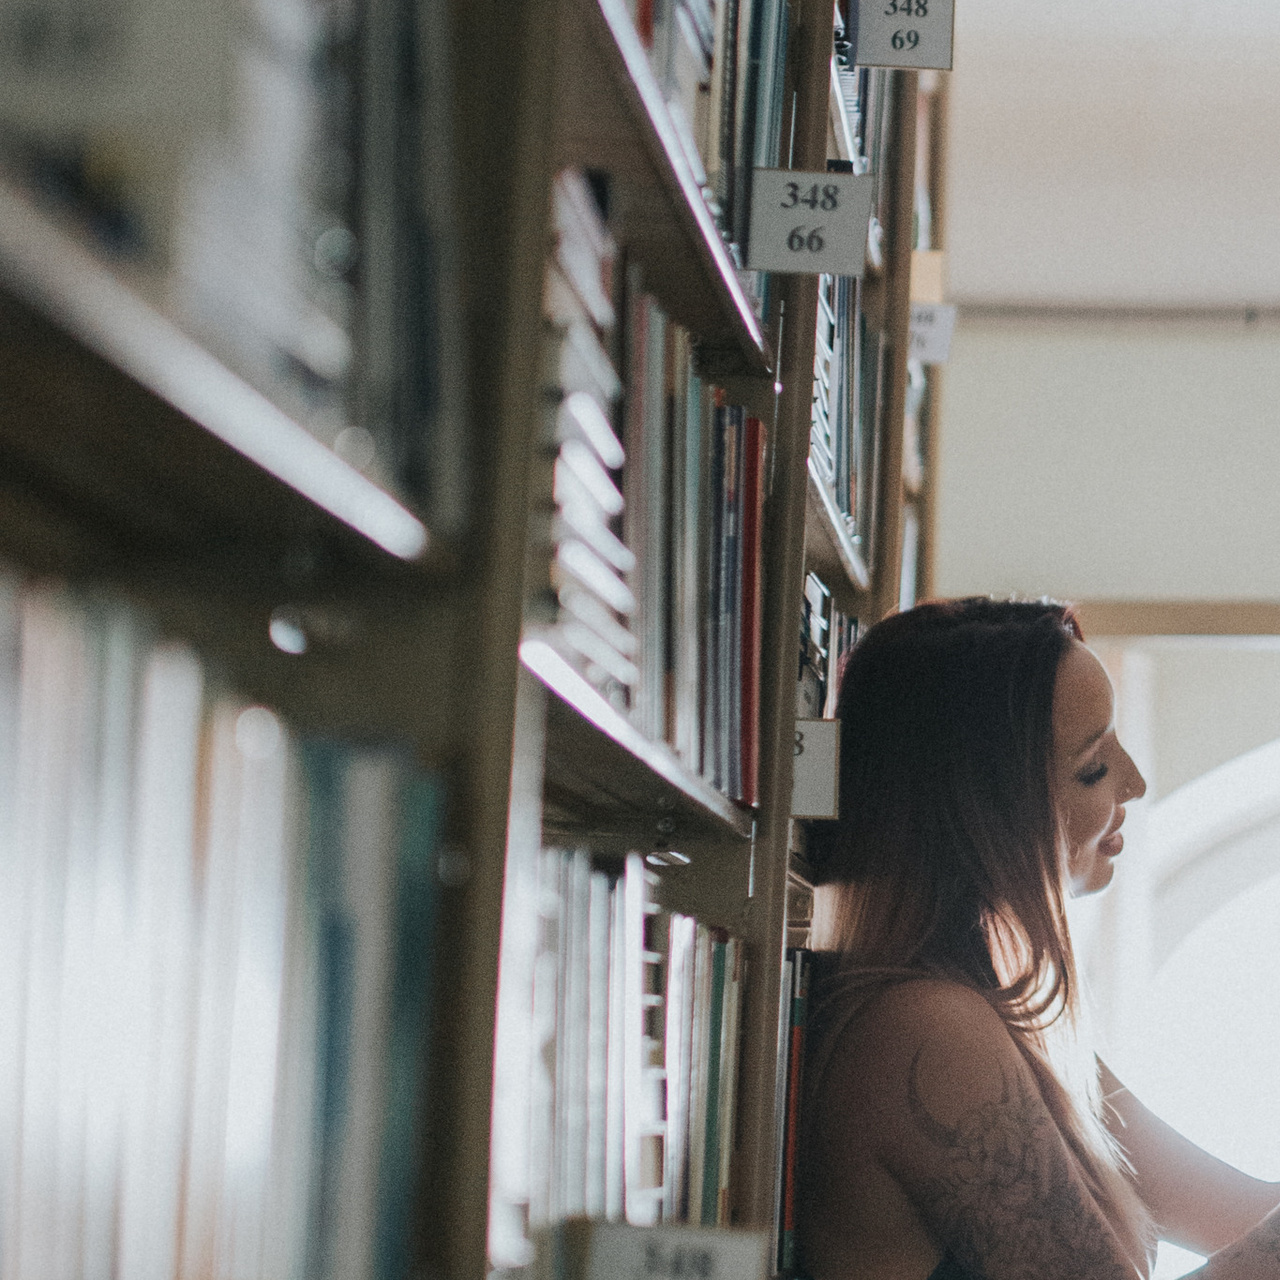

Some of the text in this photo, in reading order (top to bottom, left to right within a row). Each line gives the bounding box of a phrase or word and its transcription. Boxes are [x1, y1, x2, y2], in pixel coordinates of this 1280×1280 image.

[891, 29, 919, 52] 69
[779, 181, 839, 212] 348
[786, 224, 824, 254] 66
